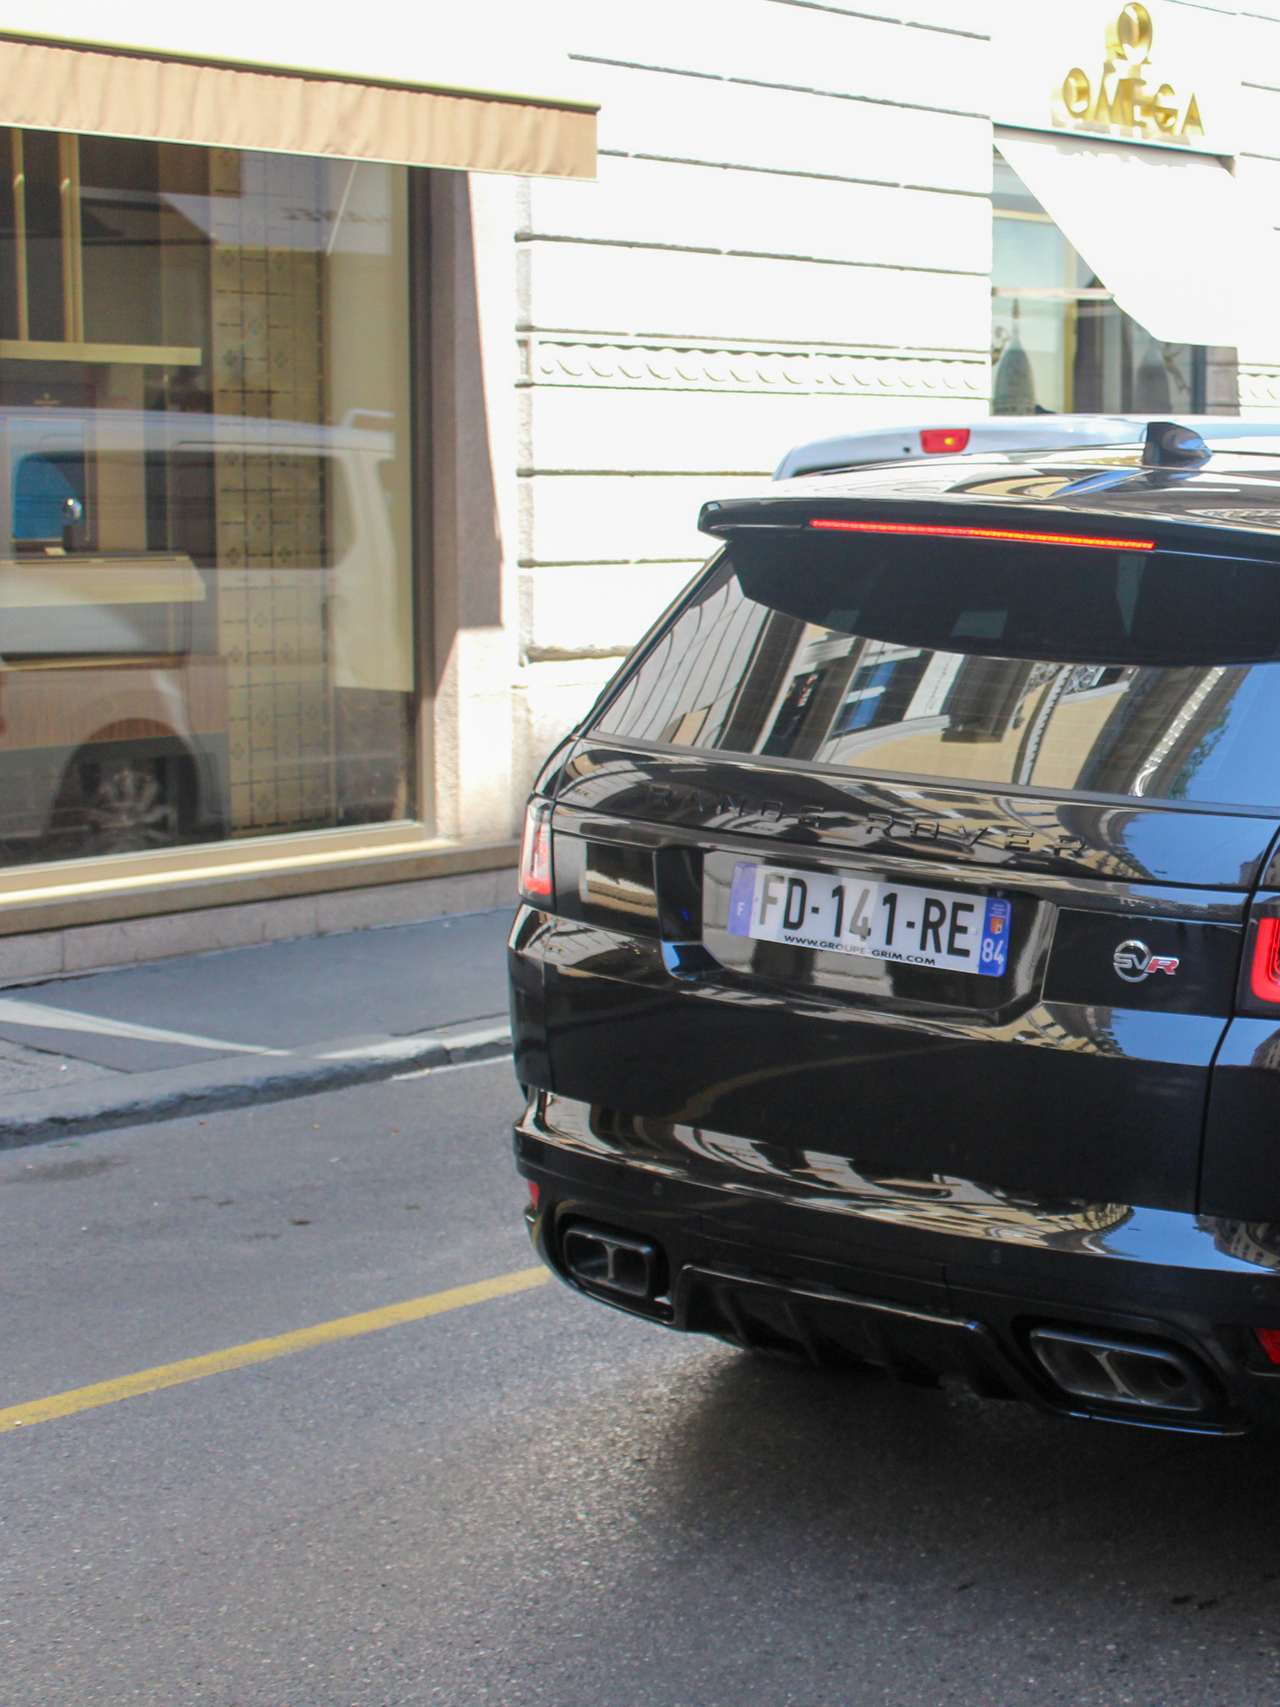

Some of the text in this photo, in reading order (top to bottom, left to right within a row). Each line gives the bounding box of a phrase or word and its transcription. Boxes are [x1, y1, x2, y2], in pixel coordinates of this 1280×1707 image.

[1052, 67, 1205, 137] OMEGA
[866, 812, 1087, 858] ROVER
[736, 901, 746, 917] F
[758, 873, 975, 958] FD-141-RE
[783, 934, 936, 966] WWW.GROUPE-GRIM.COM
[981, 937, 1005, 965] 84
[1113, 952, 1180, 976] SVR
